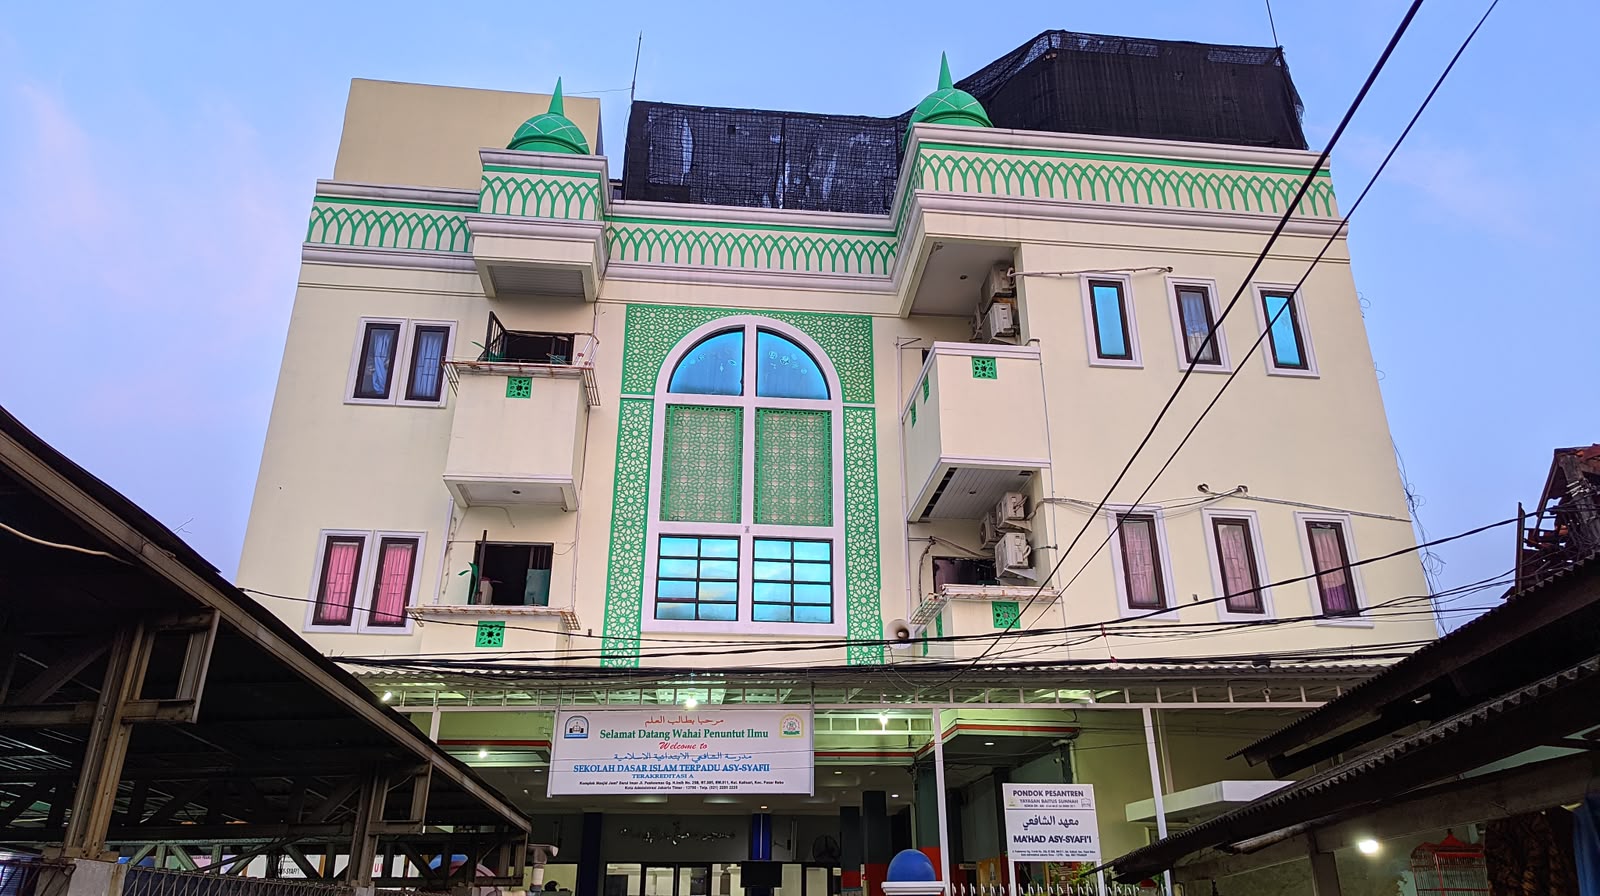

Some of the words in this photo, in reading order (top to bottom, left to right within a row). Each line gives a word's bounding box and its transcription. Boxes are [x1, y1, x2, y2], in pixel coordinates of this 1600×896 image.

[644, 716, 664, 727] العلم
[600, 729, 636, 739] Selamat
[639, 730, 670, 740] Datang
[672, 729, 701, 738] Wahai
[704, 729, 745, 738] Penuntut
[747, 729, 768, 738] Ilmu
[659, 742, 696, 750] Welcome
[700, 742, 707, 750] to
[573, 764, 615, 772] SEKOLAH
[617, 764, 647, 772] DASAR
[649, 764, 677, 772] ISLAM
[1023, 814, 1055, 830] الشافعي
[1058, 818, 1079, 828] معهد
